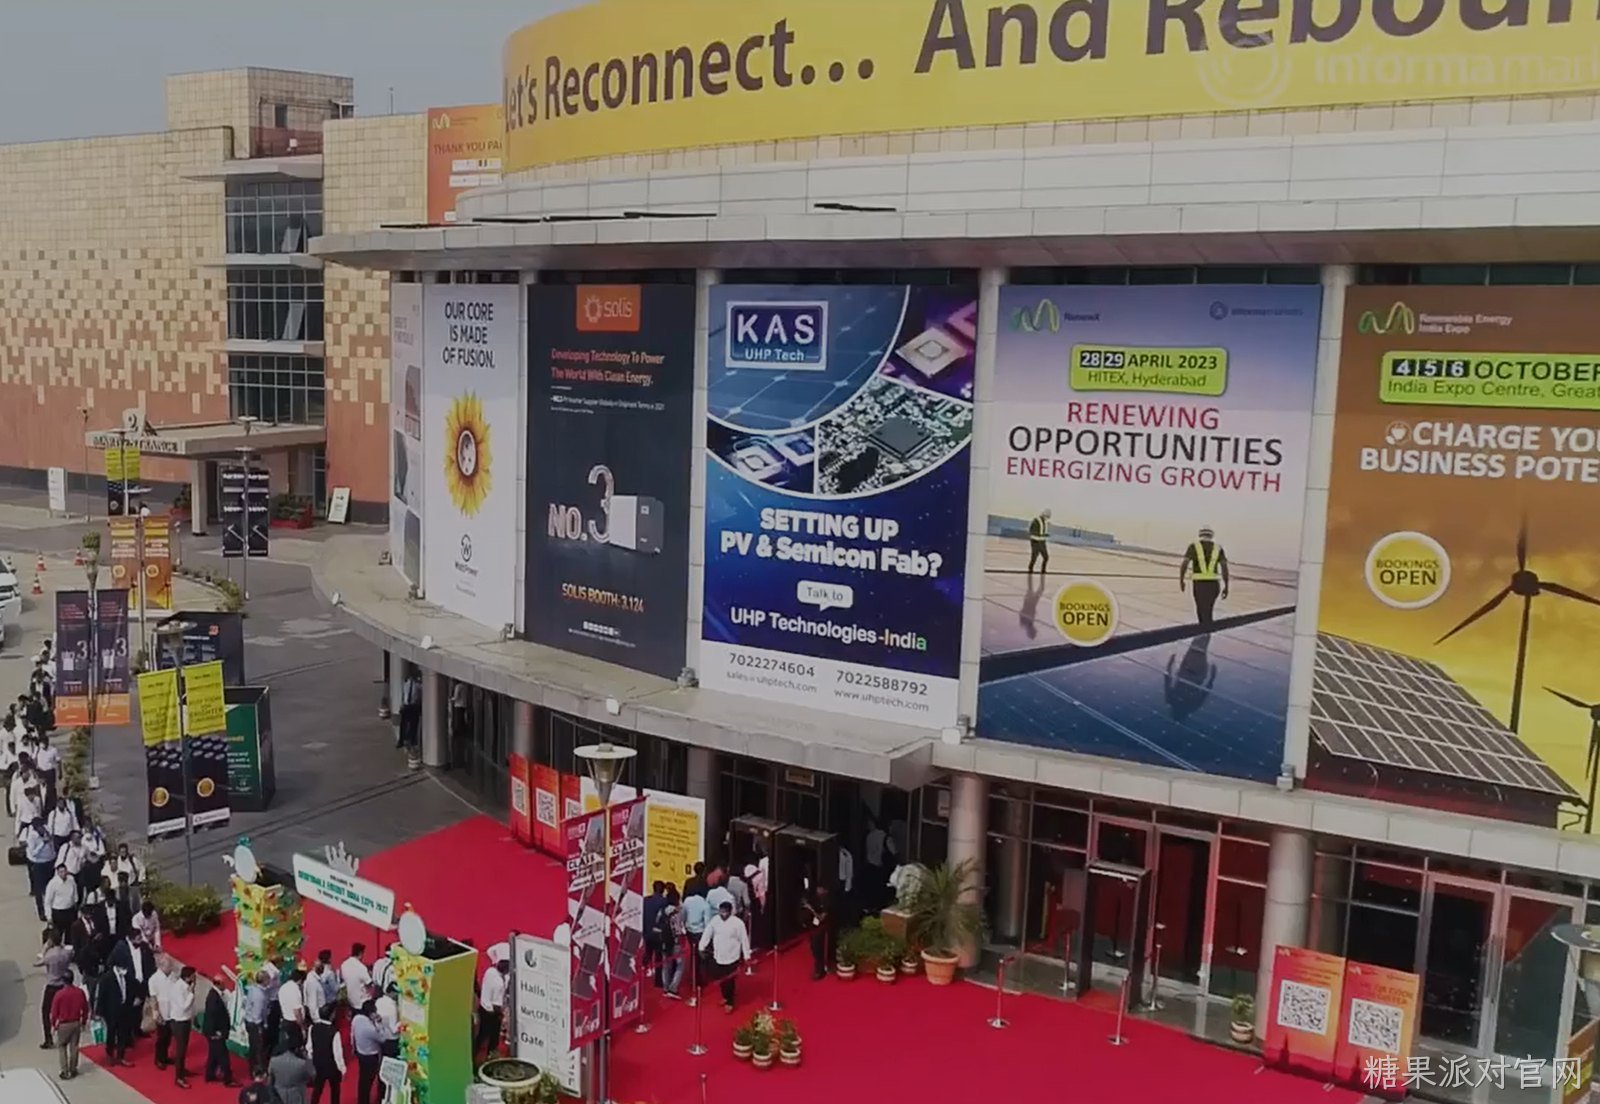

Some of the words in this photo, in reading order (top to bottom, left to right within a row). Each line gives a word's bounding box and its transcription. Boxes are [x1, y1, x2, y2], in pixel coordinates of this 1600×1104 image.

[545, 18, 874, 120] Reconnect...
[914, 0, 1109, 73] And
[444, 301, 465, 319] OUR
[466, 302, 494, 321] CORE
[603, 297, 633, 318] solis
[736, 313, 815, 345] KAS
[1419, 324, 1443, 333] India
[1445, 324, 1470, 334] Expo
[1476, 314, 1513, 326] Energy
[450, 324, 458, 342] IS
[460, 325, 488, 344] MADE
[442, 346, 457, 364] OF
[458, 348, 495, 369] FUSION.
[744, 347, 772, 361] UHP
[774, 347, 805, 362] Tech
[1080, 352, 1100, 367] 28
[1104, 353, 1125, 367] 29
[1128, 354, 1173, 368] APRIL
[1178, 354, 1218, 370] 2023
[1396, 359, 1410, 374] 4
[1424, 360, 1437, 375] 5
[1451, 361, 1465, 376] 6
[1088, 371, 1128, 386] HITEX,
[1132, 372, 1207, 388] Hyderabad
[1388, 379, 1428, 394] India
[1433, 381, 1476, 398] Expo
[1482, 382, 1545, 398] Centre,
[1067, 402, 1220, 430] RENEWING
[1009, 425, 1283, 466] OPPORTUNITIES
[1412, 421, 1542, 451] CHARGE
[1360, 447, 1505, 478] BUSINESS
[1006, 456, 1151, 484] ENERGIZING
[1161, 466, 1282, 493] GROWTH
[760, 507, 860, 539] SETTING
[864, 517, 900, 542] UP
[720, 530, 753, 556] PV
[755, 533, 773, 558] &
[776, 535, 876, 570] Semicon
[880, 547, 943, 577] Fab?
[1376, 559, 1439, 569] BOOKINGS
[1380, 569, 1437, 585] OPEN
[561, 582, 587, 601] SOLIS
[805, 585, 829, 601] Talk
[831, 589, 844, 602] to
[730, 606, 766, 625] UHP
[1062, 611, 1109, 626] OPEN
[728, 652, 816, 678] 7022274604
[835, 669, 928, 697] 7022588792
[520, 979, 546, 998] Halls
[520, 1031, 545, 1048] Gate
